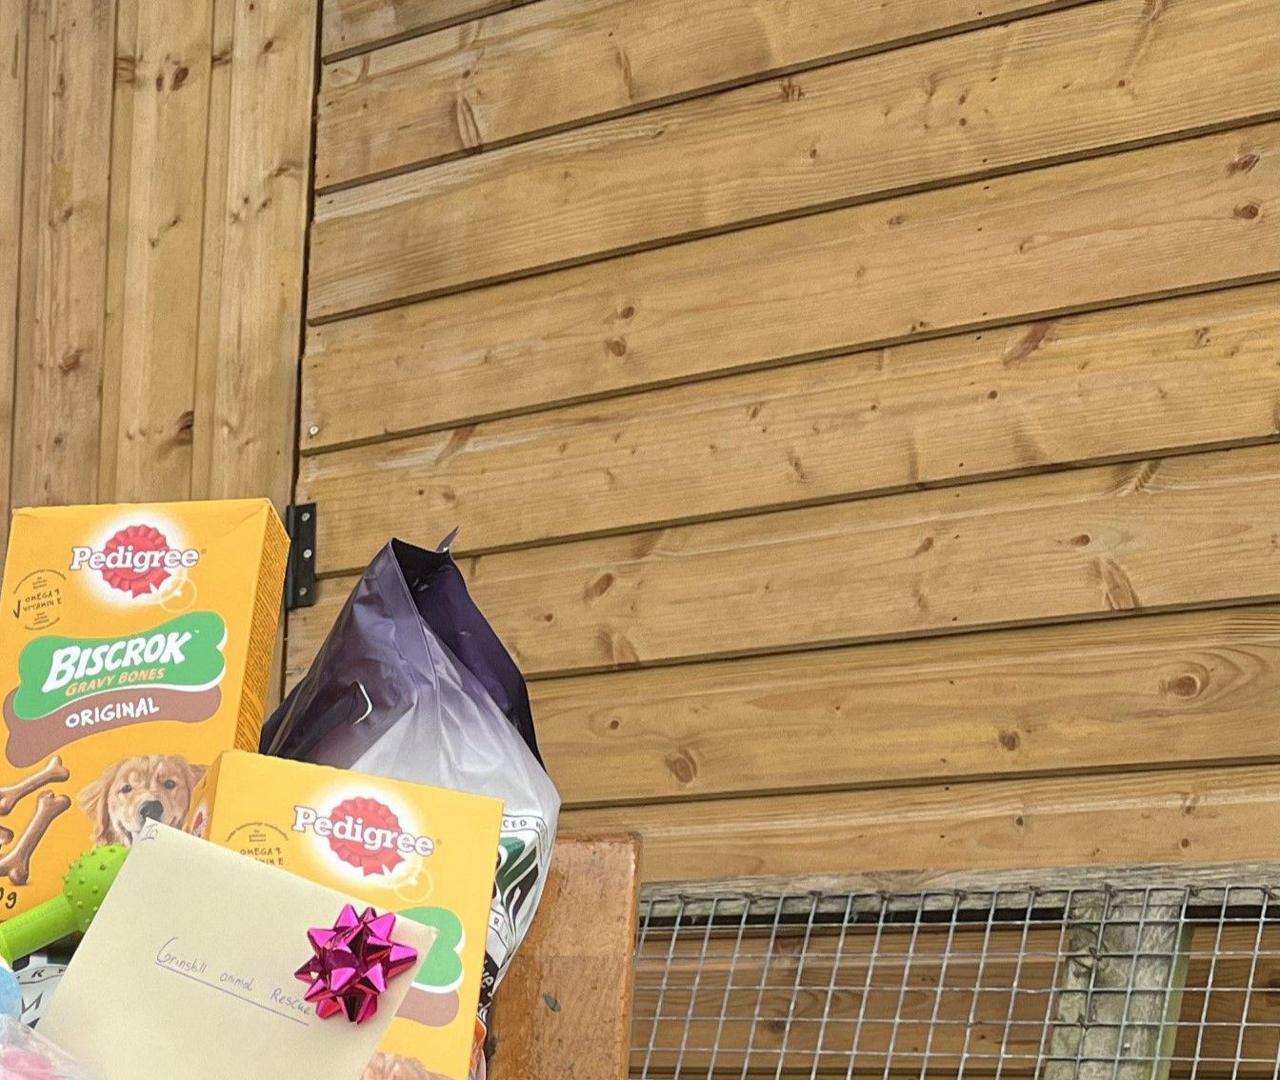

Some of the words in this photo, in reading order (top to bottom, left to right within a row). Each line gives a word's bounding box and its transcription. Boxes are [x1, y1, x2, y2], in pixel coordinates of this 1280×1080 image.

[70, 545, 200, 576] Pedigree
[41, 629, 193, 694] BISCROK
[65, 673, 114, 697] GRAVY
[118, 667, 164, 686] BONES
[64, 697, 159, 729] ORIGINAL
[292, 804, 435, 857] Pedigree
